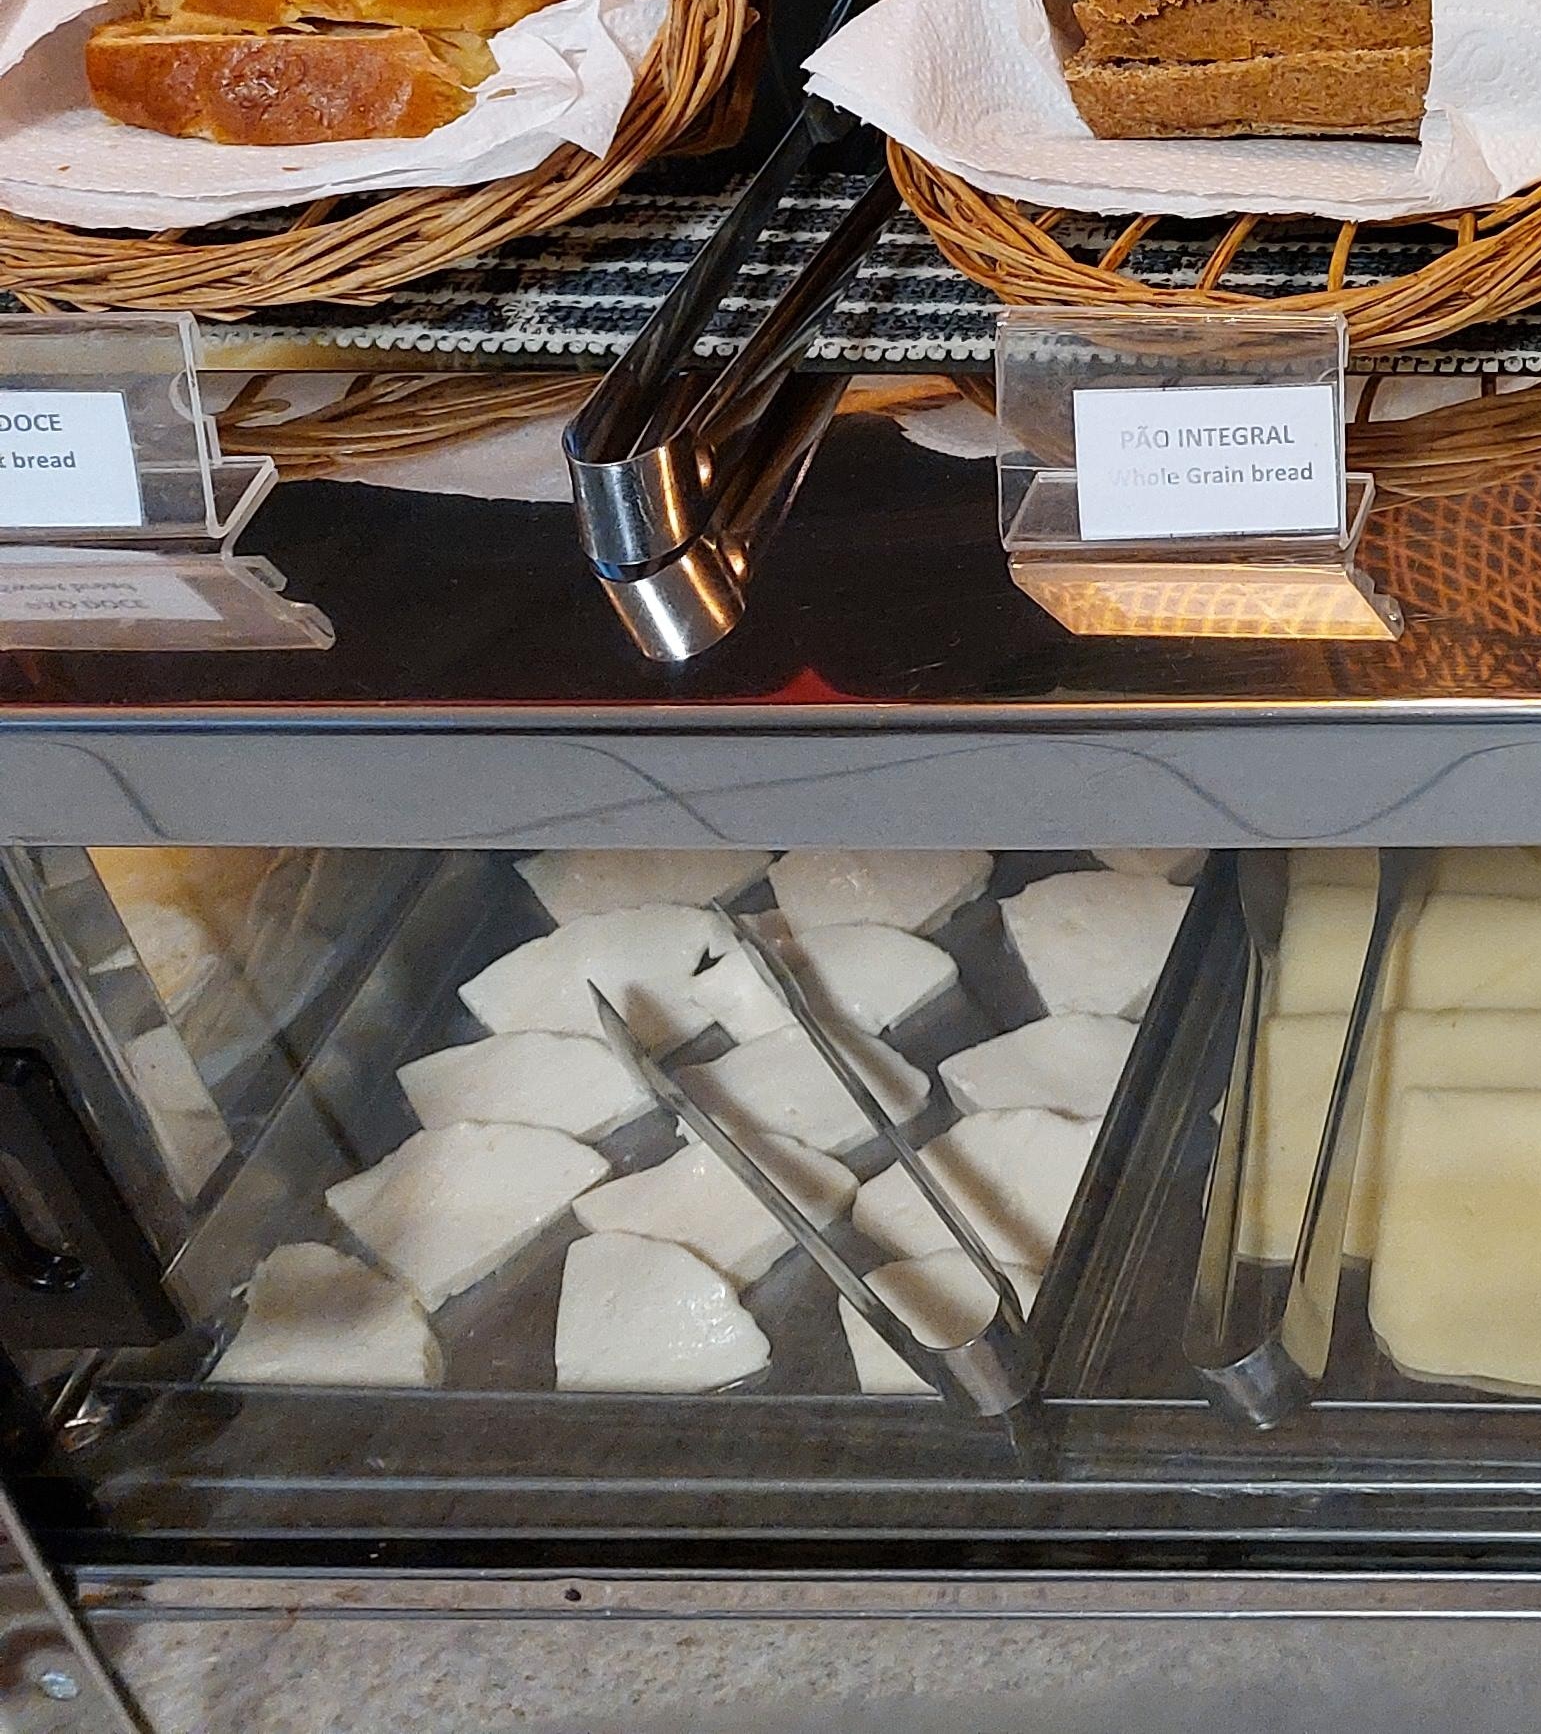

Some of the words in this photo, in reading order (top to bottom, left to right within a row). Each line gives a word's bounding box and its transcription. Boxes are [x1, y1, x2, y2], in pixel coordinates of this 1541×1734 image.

[0, 413, 63, 432] DOCE
[1120, 425, 1169, 450] PÃO
[1177, 424, 1295, 448] INTEGRAL
[12, 451, 77, 469] bread
[1113, 465, 1180, 488] Whole
[1187, 465, 1244, 486] Grain
[1250, 462, 1314, 483] bread
